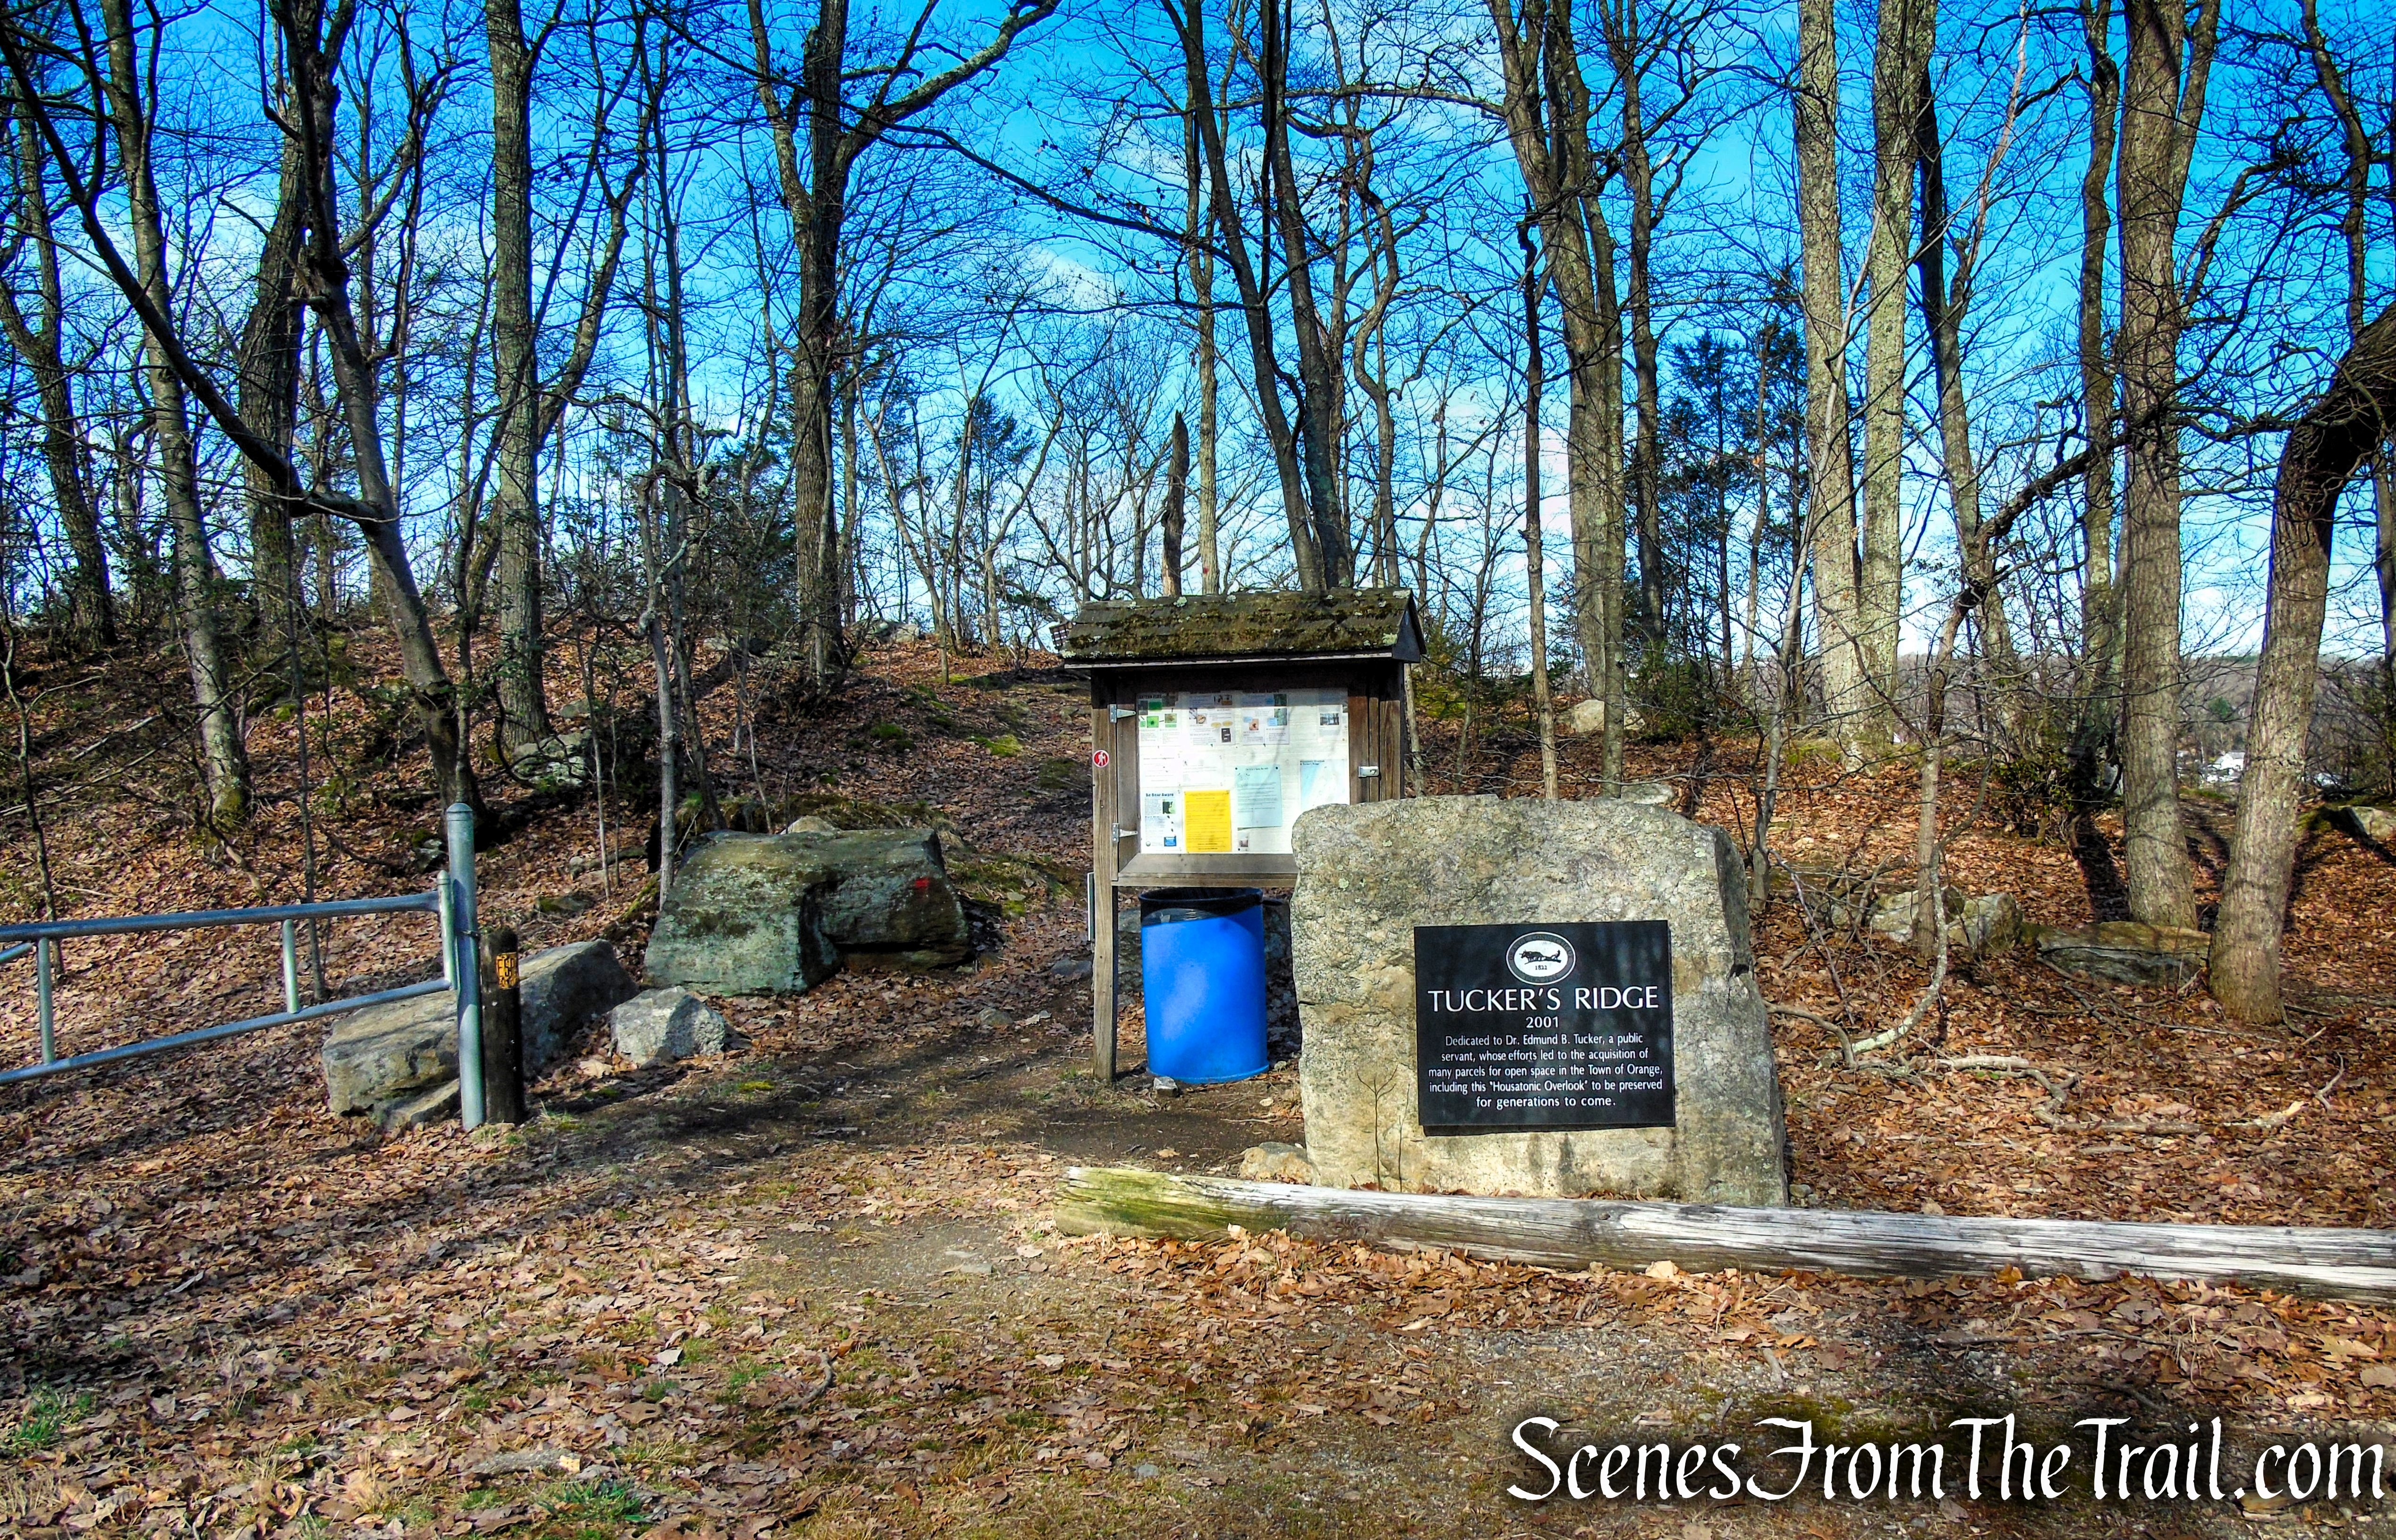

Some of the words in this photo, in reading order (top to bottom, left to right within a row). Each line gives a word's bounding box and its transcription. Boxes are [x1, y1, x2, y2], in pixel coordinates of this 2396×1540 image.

[1427, 988, 1561, 1012] TUCKER'S
[1575, 986, 1659, 1009] RIDGE
[1526, 1016, 1559, 1028] 2001
[1445, 1035, 1489, 1046] Dedicated
[1493, 1036, 1503, 1045] to
[1506, 1035, 1520, 1045] Dr.
[1523, 1033, 1558, 1045] Edmund
[1561, 1034, 1570, 1044] B.
[1573, 1033, 1605, 1046] Tucker,
[1608, 1036, 1614, 1044] a
[1617, 1032, 1643, 1047] public
[1442, 1052, 1476, 1063] servant,
[1479, 1050, 1506, 1062] whose
[1508, 1049, 1537, 1061] efforts
[1540, 1049, 1554, 1060] led
[1557, 1050, 1567, 1060] to
[1571, 1048, 1585, 1060] the
[1589, 1048, 1636, 1063] acquisition
[1639, 1047, 1648, 1059] of
[1428, 1069, 1452, 1080] many
[1455, 1065, 1486, 1080] parcels
[1488, 1065, 1501, 1076] for
[1504, 1068, 1527, 1080] open
[1530, 1067, 1555, 1079] space
[1559, 1064, 1567, 1075] in
[1570, 1064, 1585, 1075] the
[1588, 1064, 1611, 1075] Town
[1614, 1063, 1624, 1075] of
[1627, 1064, 1663, 1077] Orange,
[1429, 1081, 1468, 1095] including
[1471, 1081, 1486, 1092] this
[1489, 1081, 1542, 1092] "Housatonic
[1544, 1080, 1588, 1091] Overlook"
[1591, 1081, 1601, 1091] to
[1604, 1079, 1616, 1090] be
[1619, 1078, 1662, 1093] preserved
[1476, 1096, 1492, 1107] for
[1496, 1096, 1560, 1110] generations
[1564, 1097, 1576, 1106] to
[1581, 1098, 1615, 1106] come.
